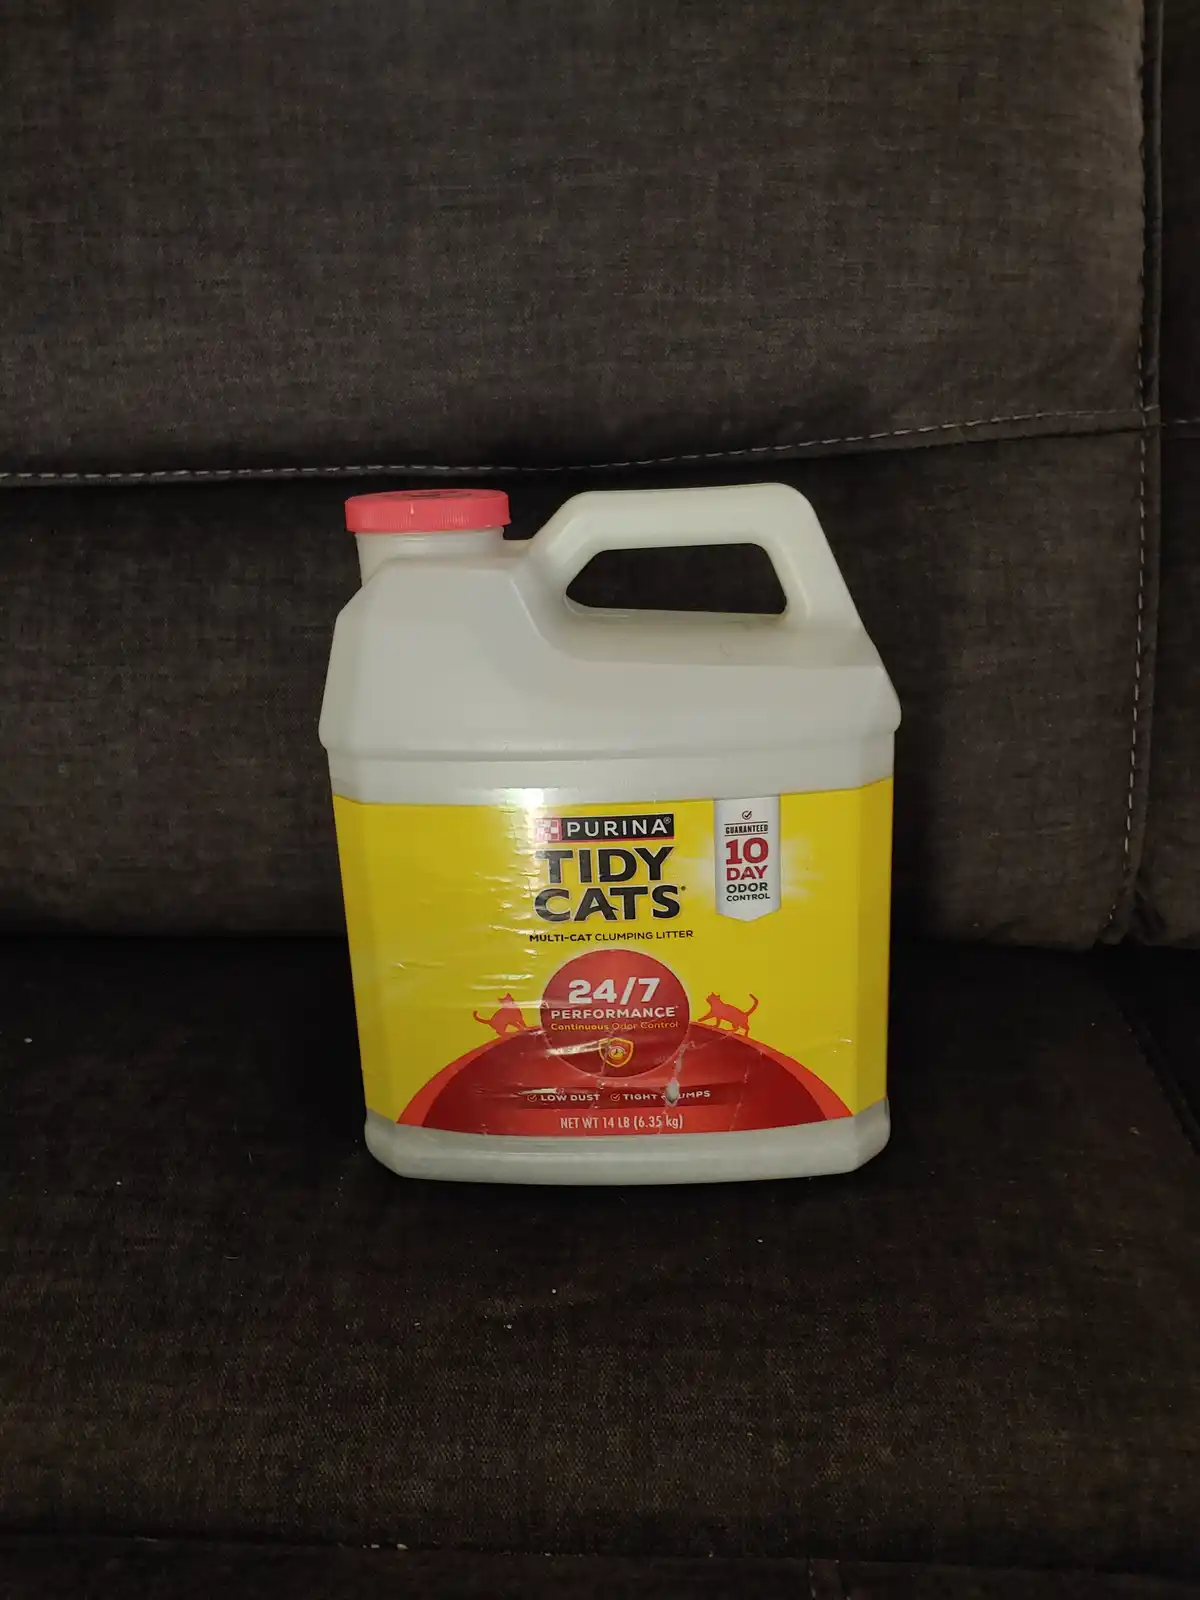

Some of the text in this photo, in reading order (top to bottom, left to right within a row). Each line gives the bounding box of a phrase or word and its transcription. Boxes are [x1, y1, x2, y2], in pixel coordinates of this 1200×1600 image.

[725, 824, 769, 835] GUARANTEED
[725, 837, 769, 866] 10
[535, 846, 675, 884] TIDY
[726, 865, 768, 881] DAY
[726, 882, 769, 893] ODOR
[533, 885, 681, 922] CATS
[726, 893, 771, 902] CONTROL
[529, 929, 694, 943] MULTI-CAT CLUMPING LITTER
[568, 977, 660, 1005] 24/7
[551, 1007, 677, 1020] PERFORMANCE
[551, 1020, 679, 1031] Continuous Odor Control
[540, 1094, 601, 1102] LOW DUST
[623, 1093, 658, 1101] TIGHT
[560, 1115, 684, 1130] NET WT 14 LB (6.35 kg)
